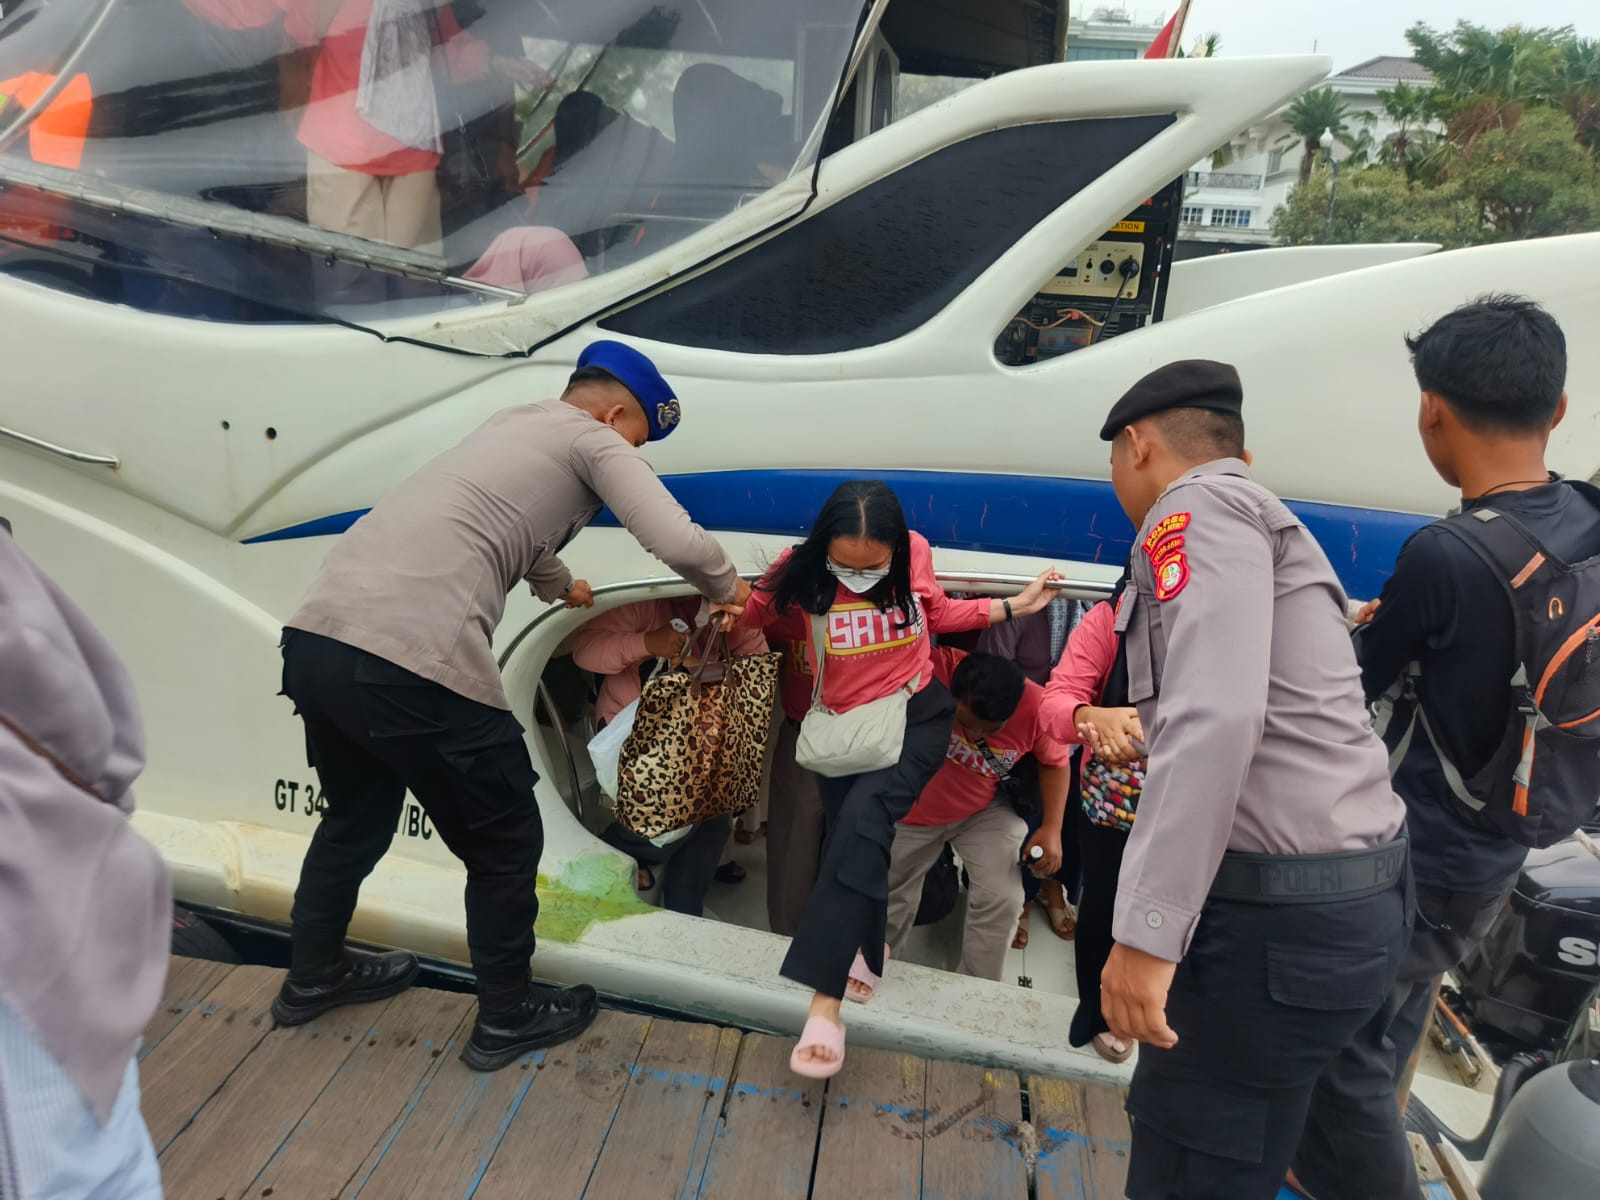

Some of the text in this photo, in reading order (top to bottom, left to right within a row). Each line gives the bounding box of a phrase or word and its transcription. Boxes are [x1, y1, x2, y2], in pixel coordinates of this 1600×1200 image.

[1112, 222, 1140, 231] ATION
[274, 778, 299, 813] GT
[304, 784, 326, 819] 34
[1264, 862, 1344, 893] POLRI
[1557, 936, 1600, 968] S
